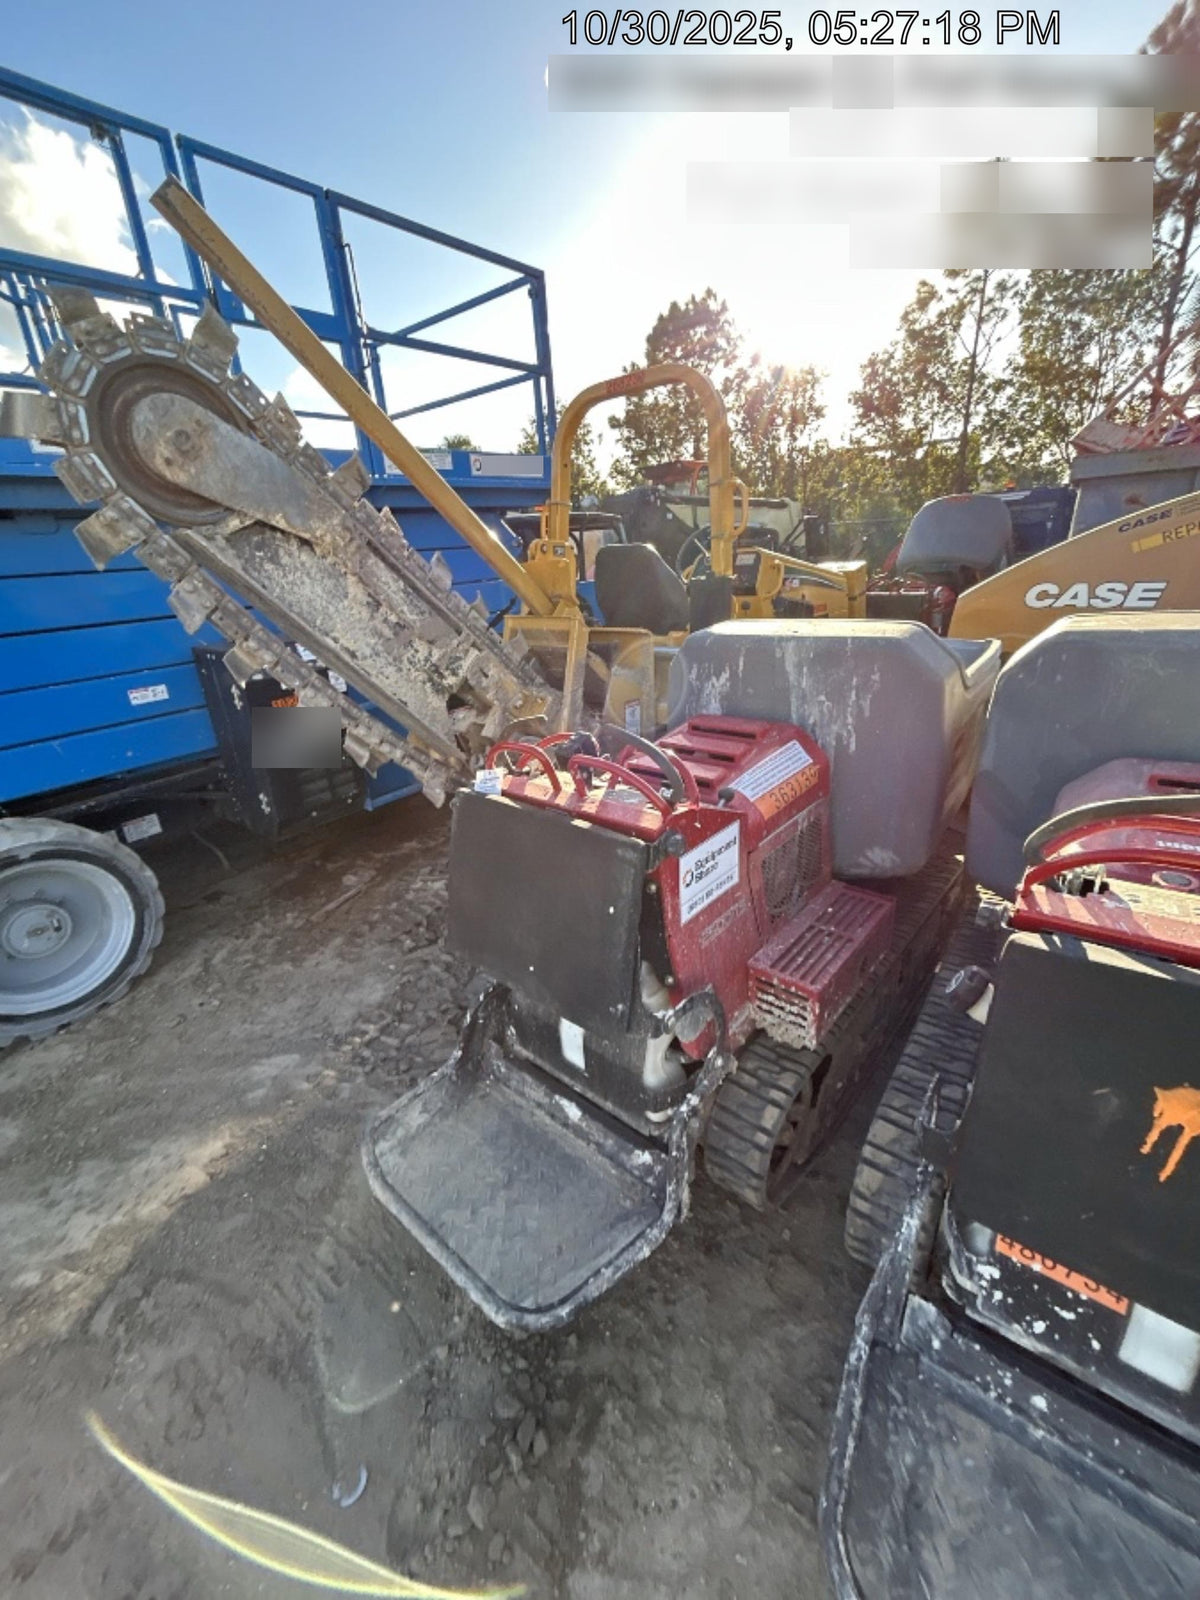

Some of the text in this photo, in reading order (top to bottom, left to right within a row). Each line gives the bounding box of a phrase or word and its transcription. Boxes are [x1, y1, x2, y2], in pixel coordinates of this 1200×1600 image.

[1118, 508, 1174, 532] CASE
[1162, 521, 1200, 543] REP
[1024, 580, 1168, 609] CASE
